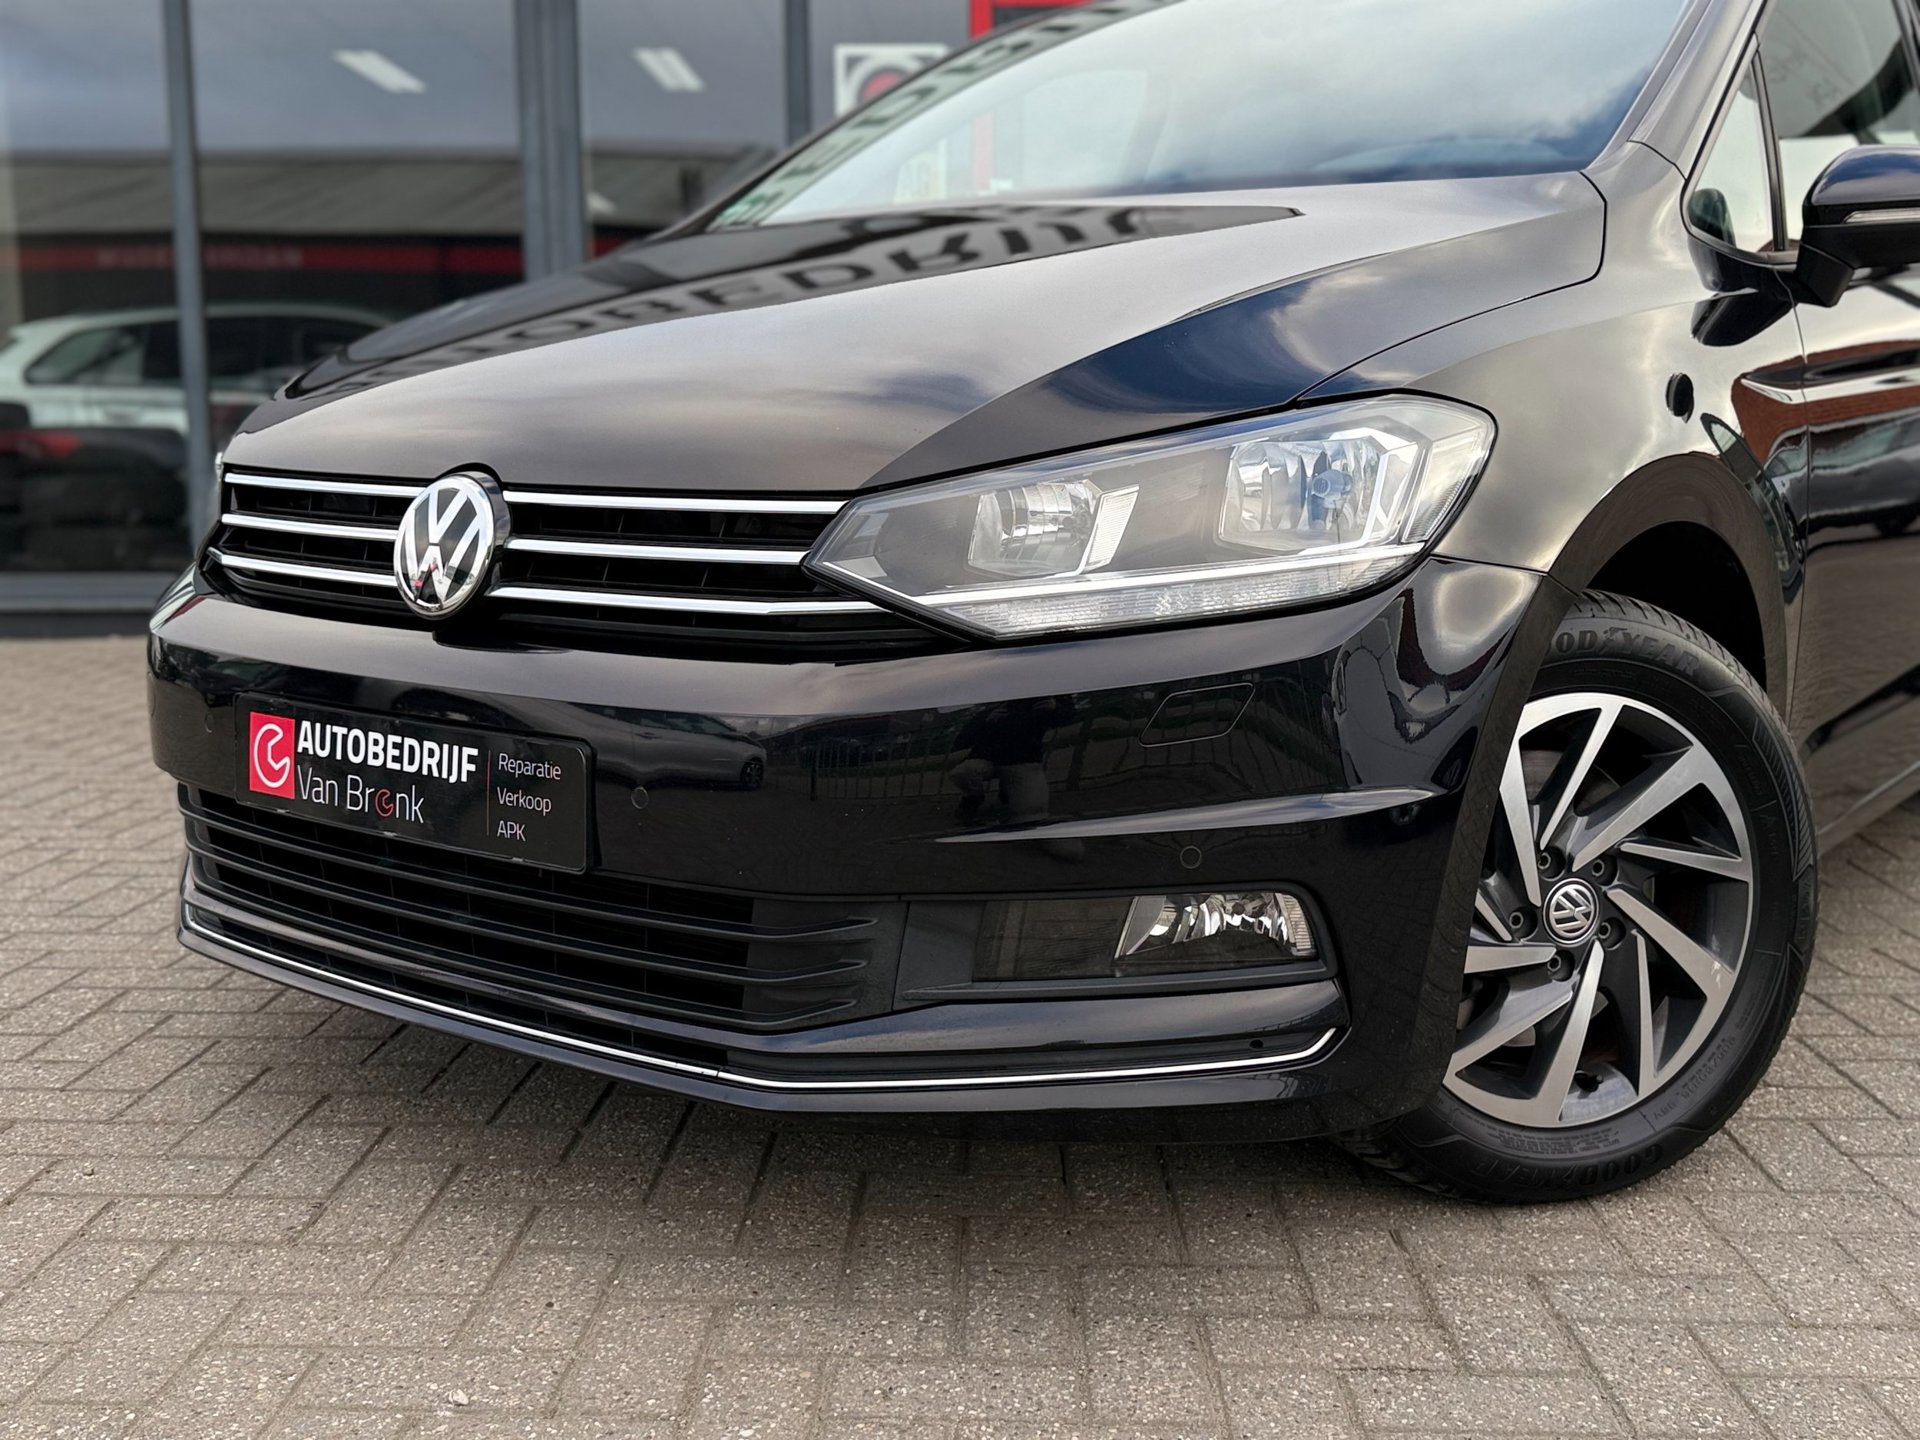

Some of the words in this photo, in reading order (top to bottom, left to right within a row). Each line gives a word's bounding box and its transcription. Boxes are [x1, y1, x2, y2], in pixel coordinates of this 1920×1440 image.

[1549, 627, 1701, 677] ODYEAR
[297, 720, 479, 784] AUTOBEDRIJF
[498, 752, 562, 780] Reparatie
[297, 764, 338, 807] Van
[497, 786, 552, 816] Verkoop
[497, 820, 526, 842] APK
